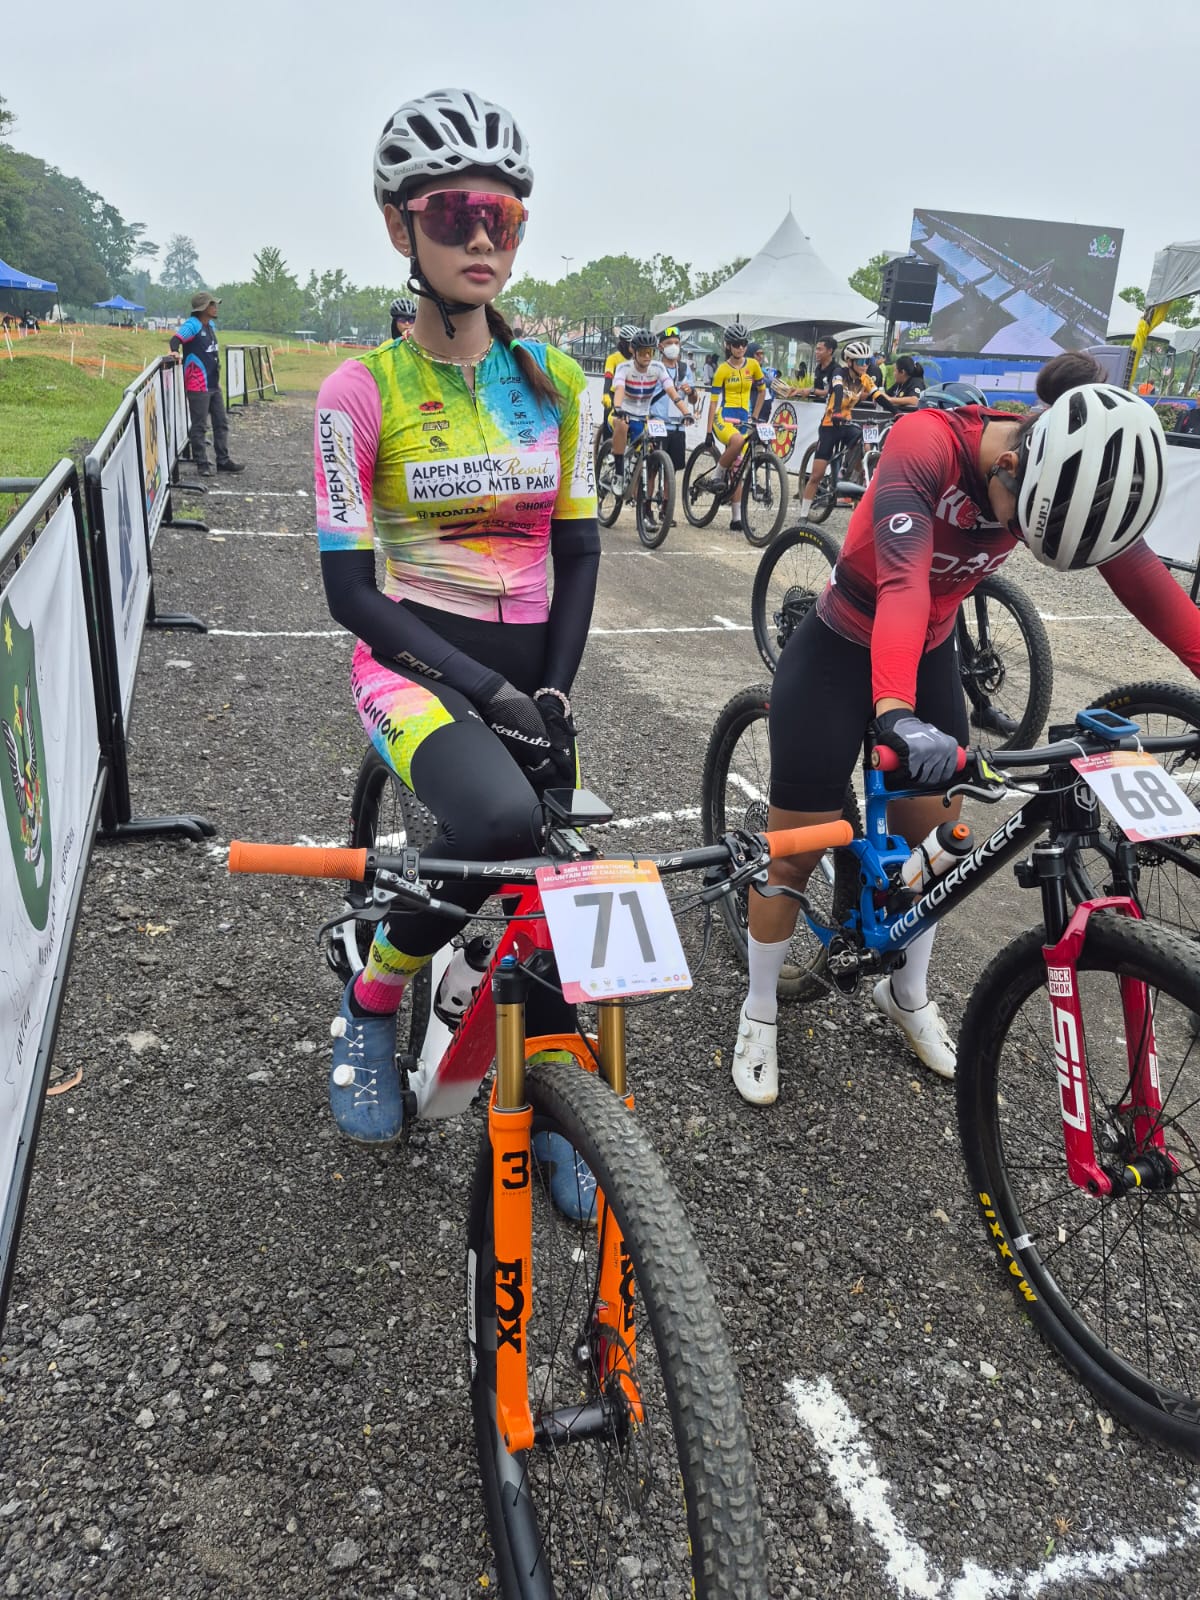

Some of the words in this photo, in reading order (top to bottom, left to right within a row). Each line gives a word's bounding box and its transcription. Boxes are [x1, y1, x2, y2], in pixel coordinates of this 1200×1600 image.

[319, 412, 338, 463] BLICK
[650, 423, 665, 433] 125
[412, 463, 459, 480] ALPEN
[463, 458, 502, 475] BLICK
[497, 456, 553, 477] Resort
[413, 479, 482, 500] MYOKO
[488, 477, 521, 491] MTB
[526, 474, 555, 490] PARK
[587, 451, 596, 494] BLICK
[327, 470, 349, 523] ALPEN
[430, 506, 488, 518] HONDA
[1033, 497, 1051, 539] GIRO
[363, 697, 405, 746] UNION
[491, 721, 552, 749] Kabuto
[1111, 769, 1183, 821] 68
[482, 865, 536, 877] V-DRI
[889, 809, 1027, 942] MONDRAKER
[573, 890, 657, 969] 71
[1050, 967, 1070, 982] ROCK
[1050, 982, 1071, 995] SHOX
[1050, 1001, 1088, 1133] SID
[501, 1150, 530, 1191] 3
[977, 1189, 1038, 1303] MAXXIS
[496, 1257, 525, 1354] FOX
